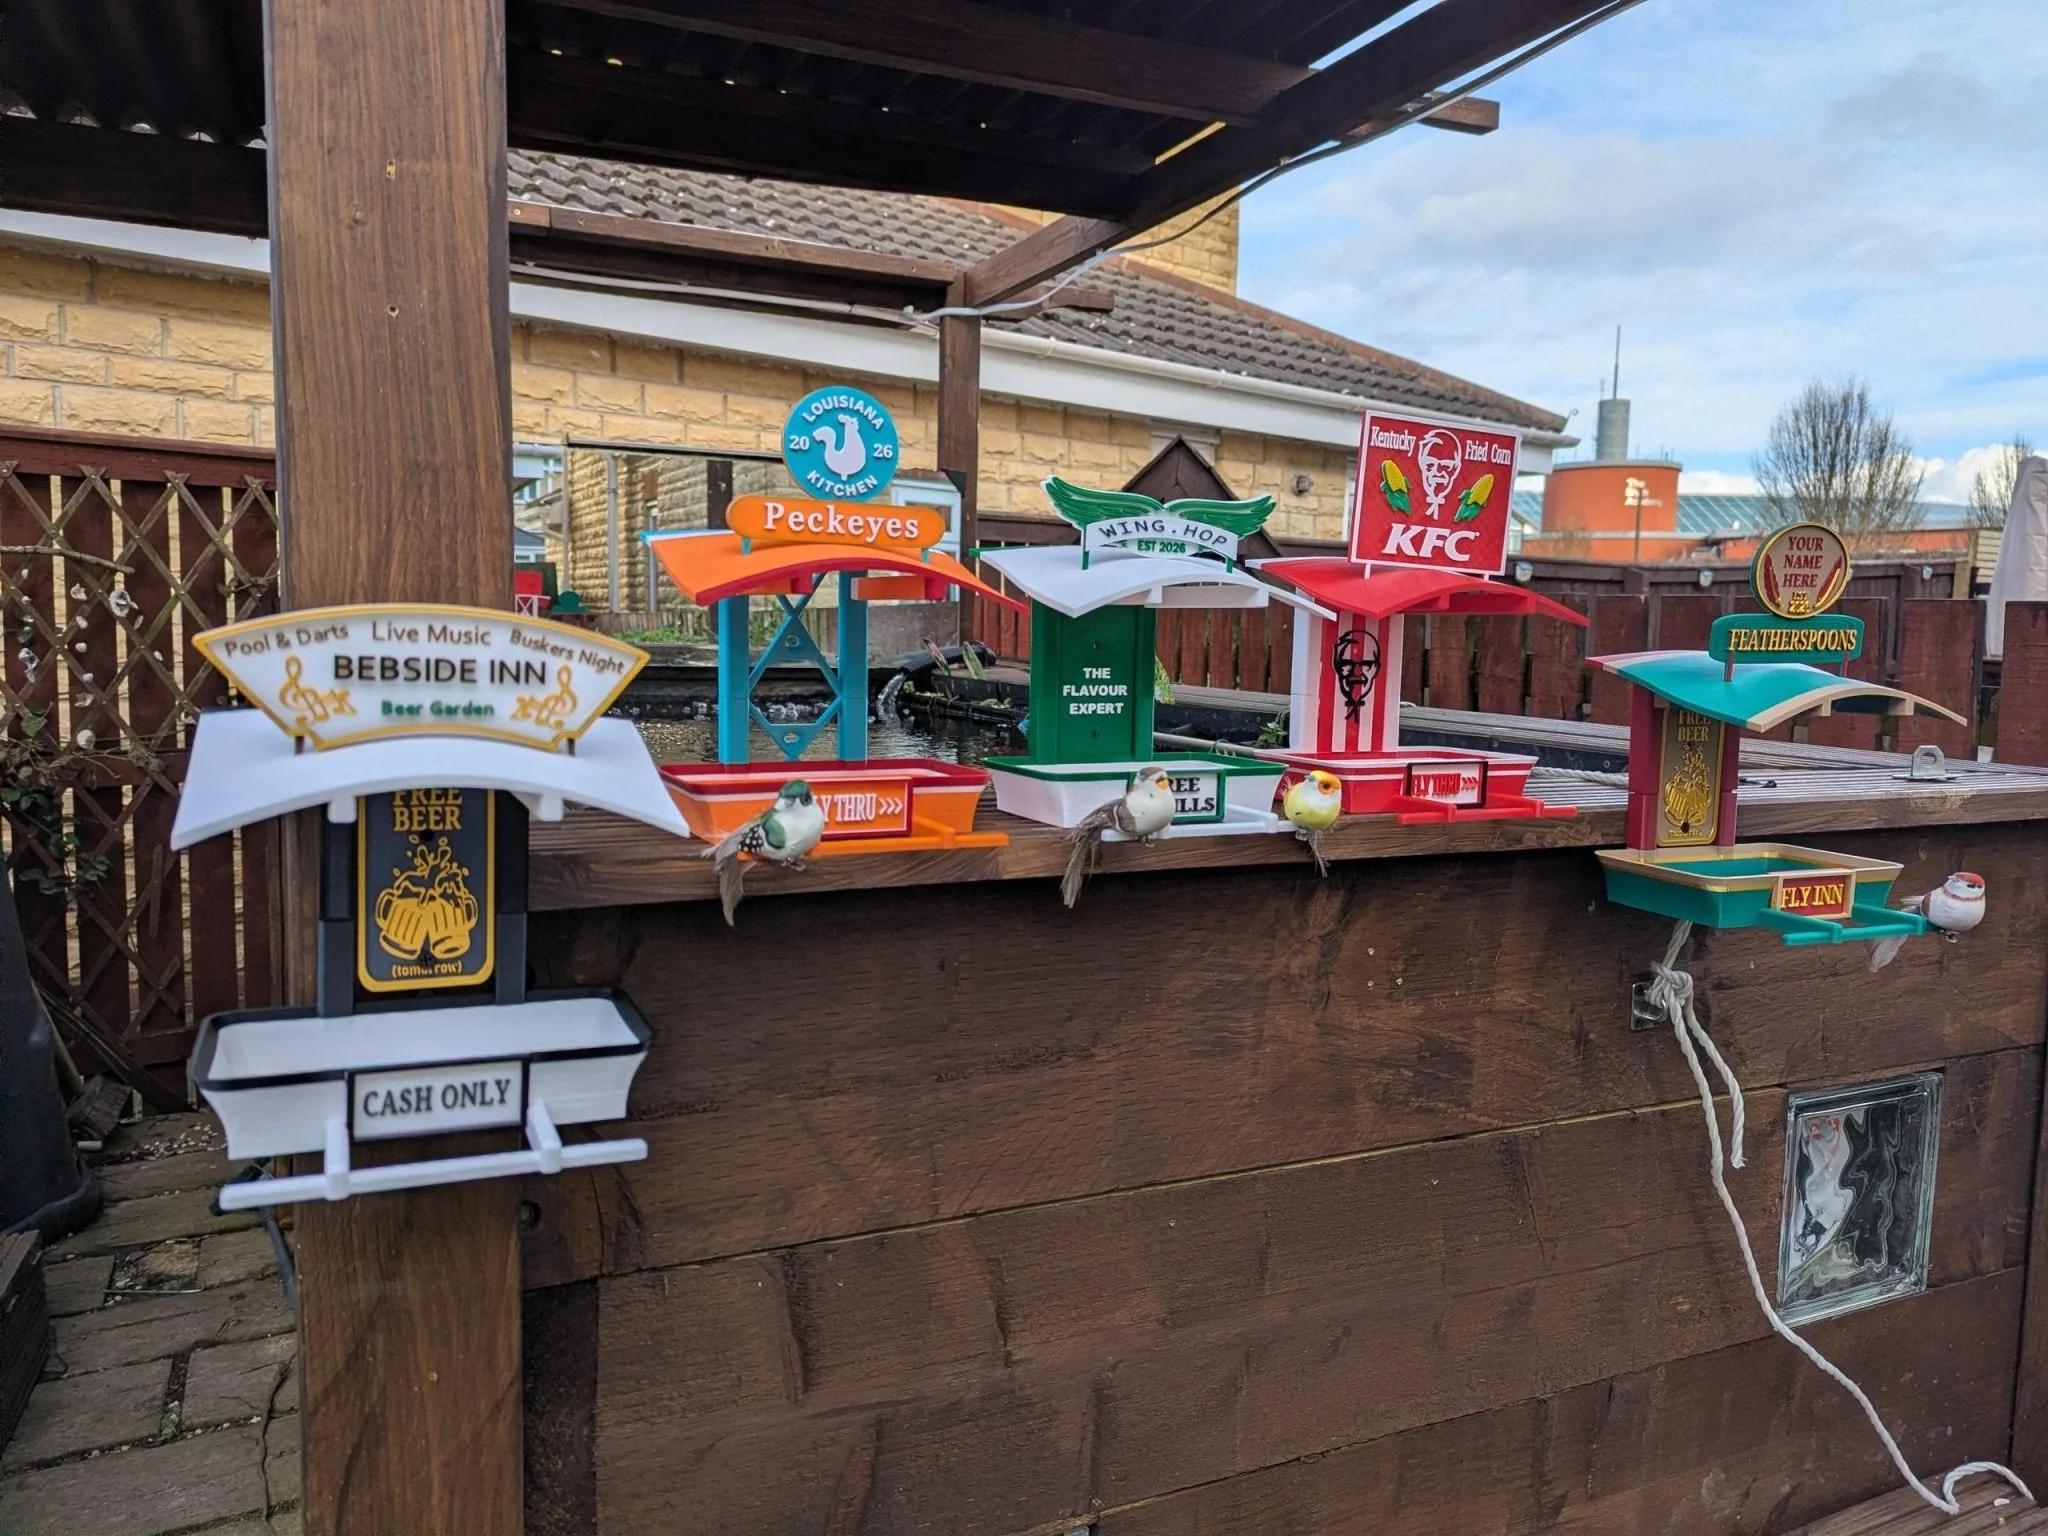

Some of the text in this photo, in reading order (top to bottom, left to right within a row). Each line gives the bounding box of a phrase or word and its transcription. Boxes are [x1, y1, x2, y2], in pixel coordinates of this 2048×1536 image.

[802, 395, 885, 430] LOUISIANA
[789, 435, 893, 458] 20 26
[1370, 426, 1416, 457] Kentucky
[1465, 440, 1511, 465] Fried Corn
[807, 470, 878, 497] KITCHEN
[763, 502, 919, 543] Peckeyes
[1137, 540, 1186, 553] EST 2026
[1381, 523, 1478, 561] KFC
[1788, 536, 1823, 551] YOUR
[1783, 554, 1823, 569] NAME
[1782, 573, 1818, 588] HERE
[225, 625, 349, 657] Pool & Darts
[372, 621, 491, 645] Live Music
[1728, 628, 1857, 651] FEATHERSPOONS
[510, 628, 624, 674] Buskers Night
[334, 655, 546, 684] BEBSIDE INN
[1083, 668, 1111, 679] THE
[1062, 684, 1128, 696] FLAVOUR
[381, 700, 494, 717] Beer Garden
[1069, 703, 1124, 715] EXPERT
[1678, 726, 1709, 742] BEER
[1432, 773, 1461, 796] THRU
[393, 806, 462, 831] BEER
[833, 793, 877, 821] THRU
[1780, 884, 1844, 908] FLY INN
[363, 1079, 511, 1117] CASH ONLY
